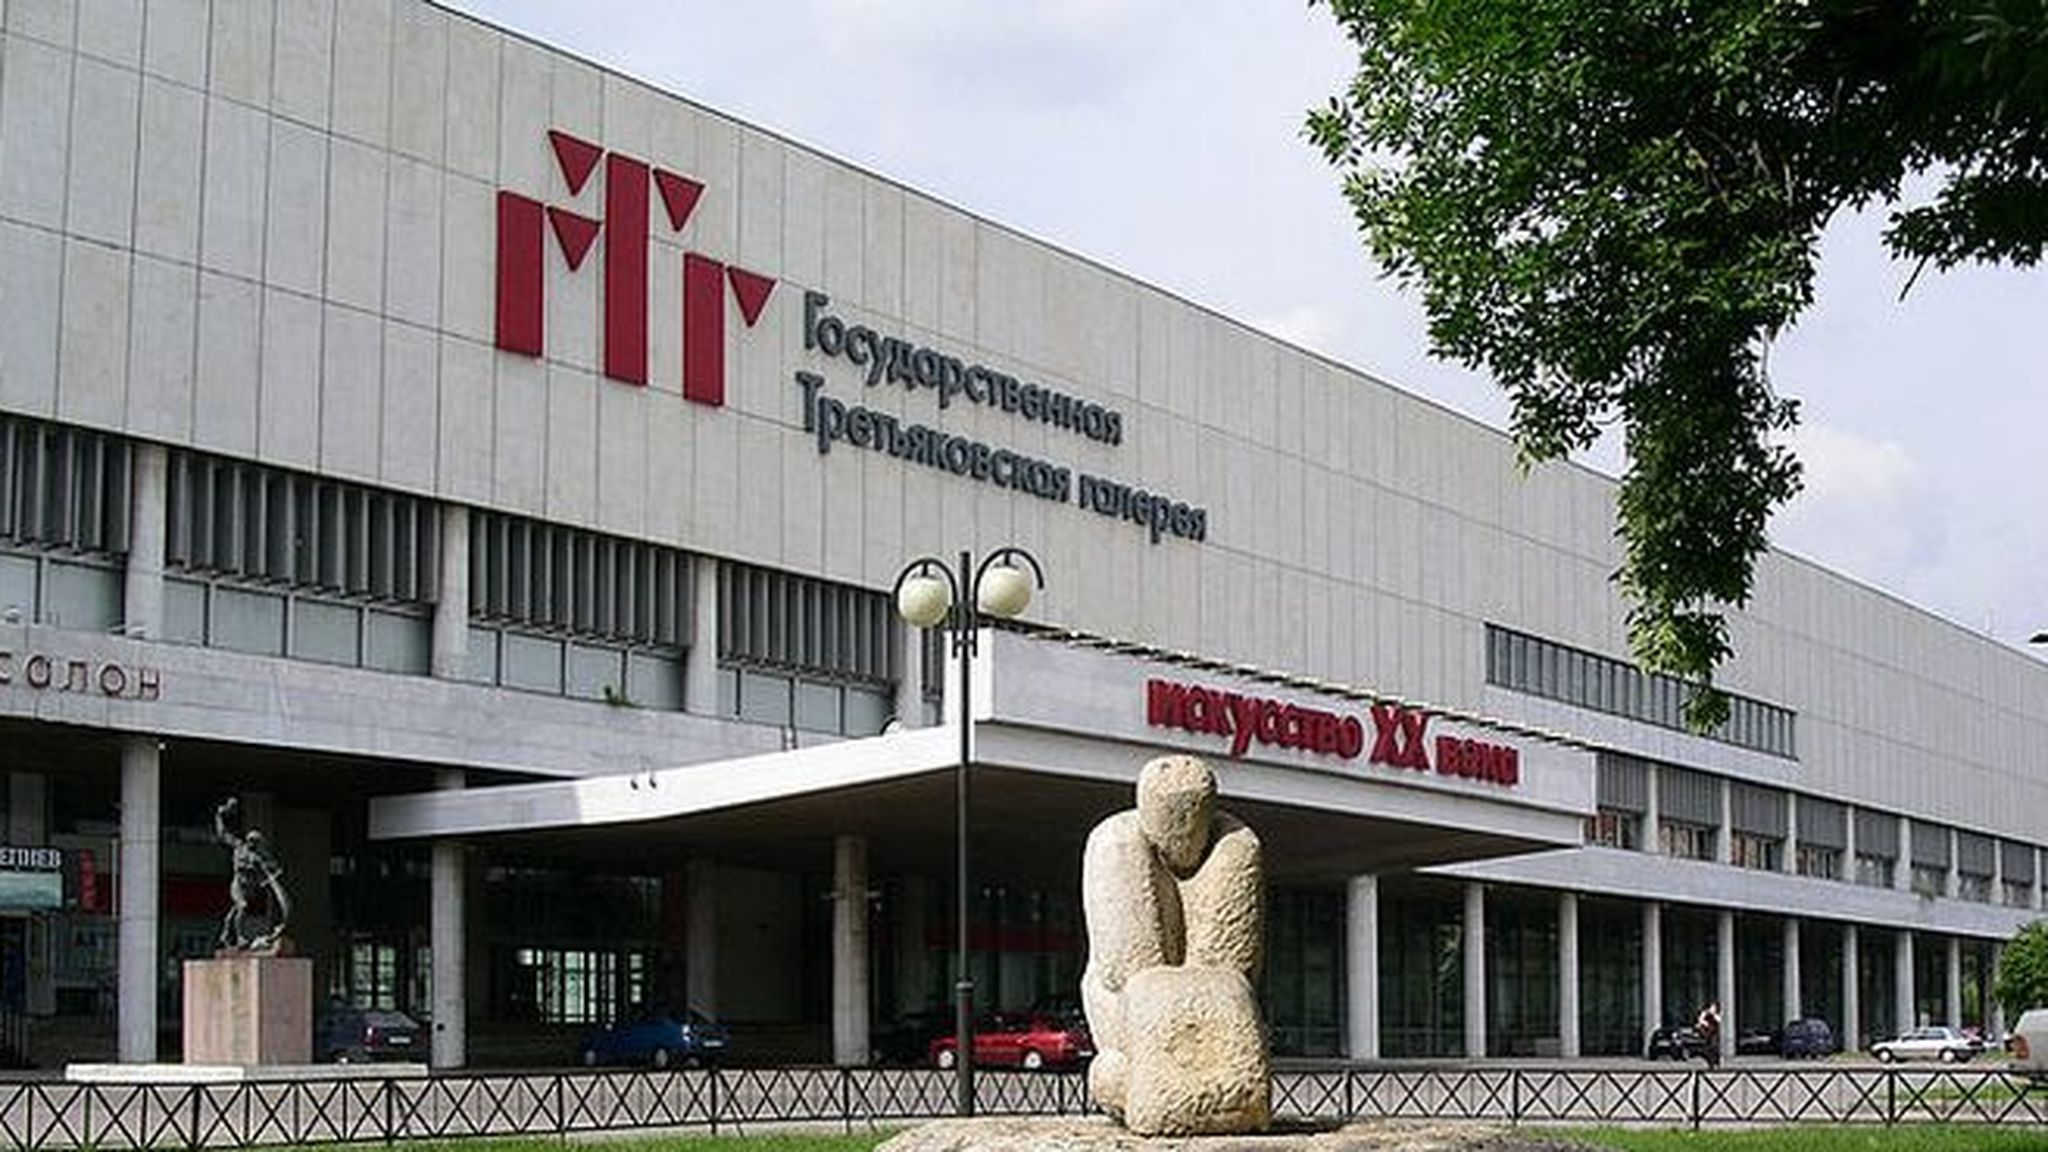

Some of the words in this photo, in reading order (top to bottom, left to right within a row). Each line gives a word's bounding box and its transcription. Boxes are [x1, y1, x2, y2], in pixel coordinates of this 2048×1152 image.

[803, 290, 1124, 446] Государственная
[796, 371, 1072, 503] Третьяковская
[1078, 473, 1208, 544] галерея
[1147, 678, 1363, 758] искусство
[1434, 735, 1519, 785] века
